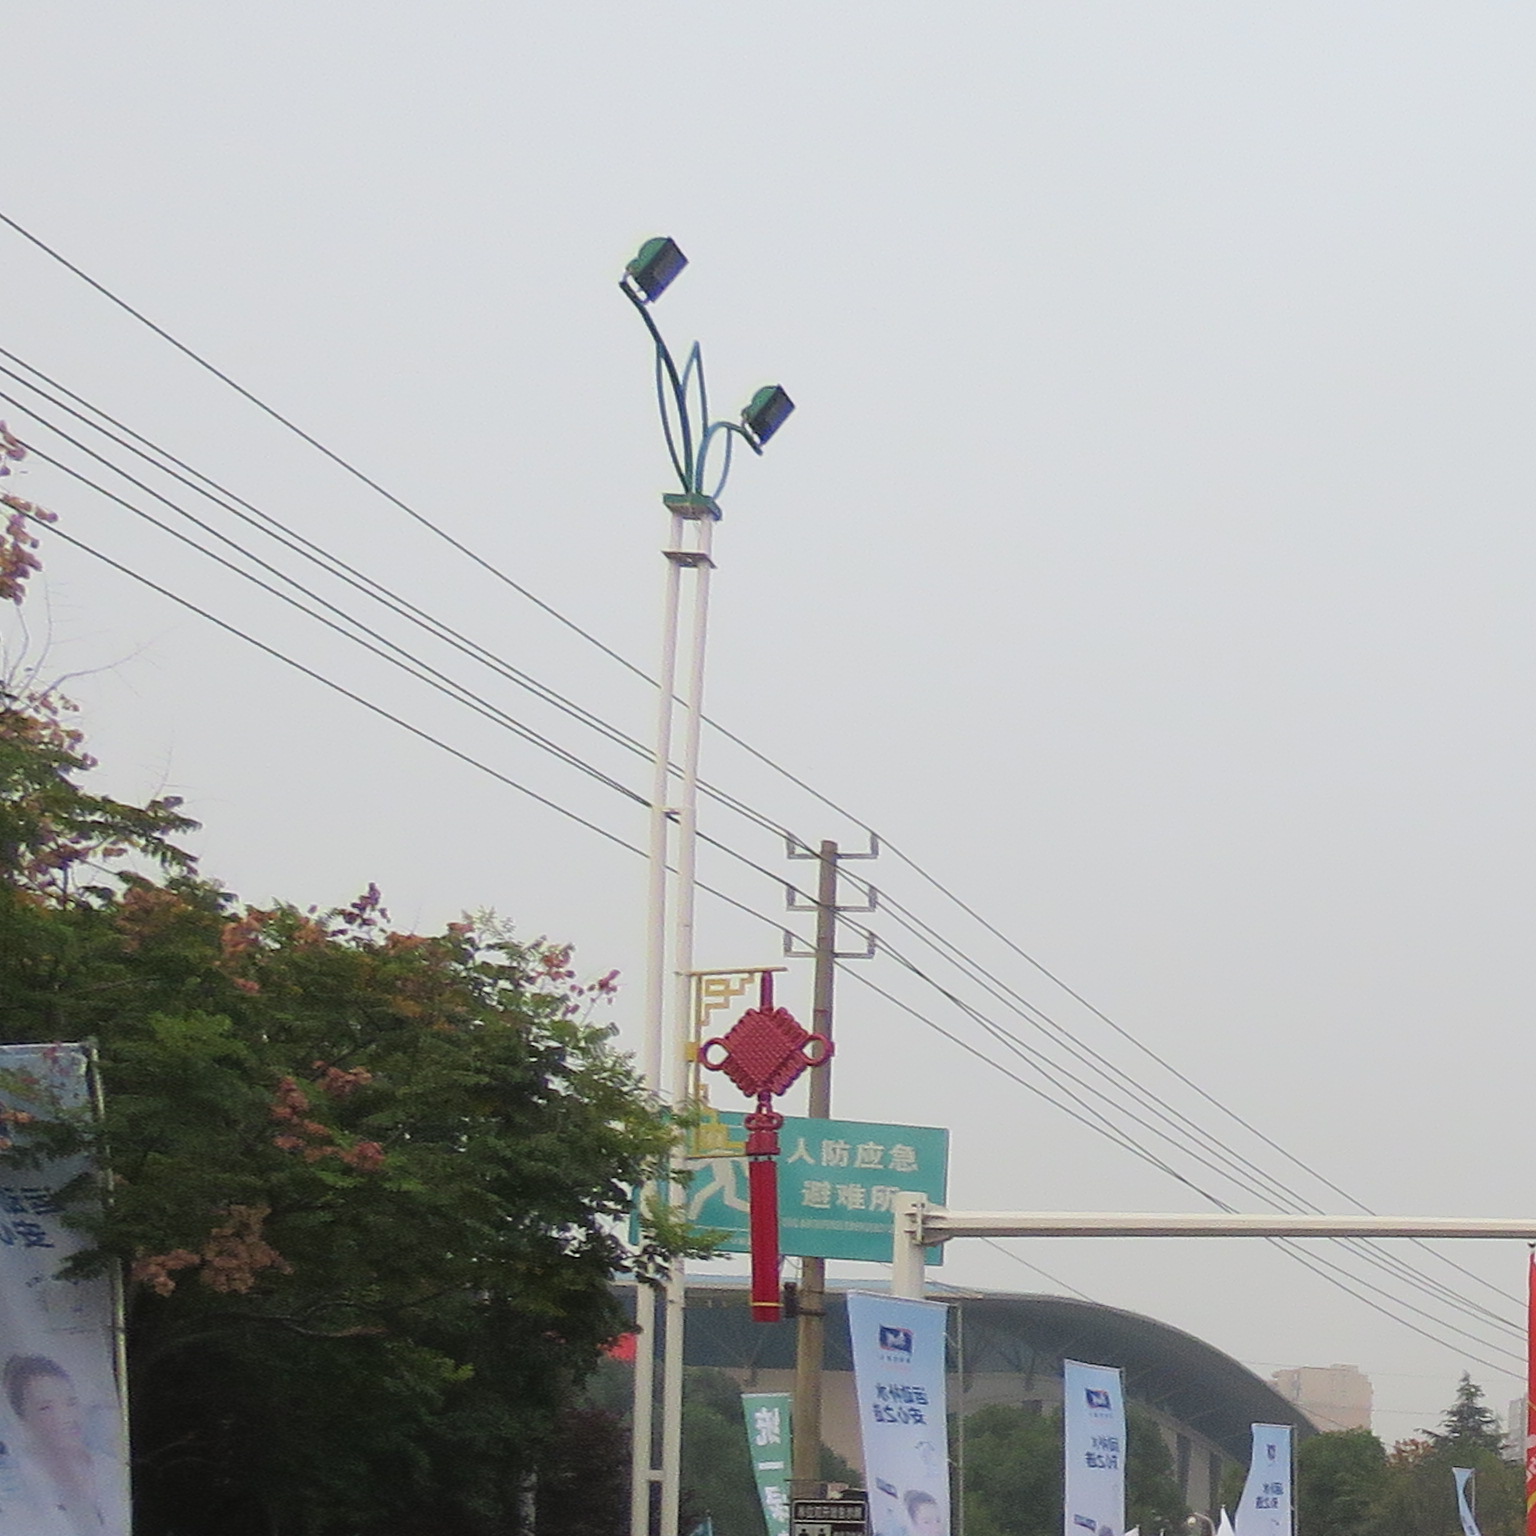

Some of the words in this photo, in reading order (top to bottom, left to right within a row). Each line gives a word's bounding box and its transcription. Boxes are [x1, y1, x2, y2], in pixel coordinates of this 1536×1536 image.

[787, 1138, 919, 1172] 人防应急
[801, 1181, 899, 1212] 避难所
